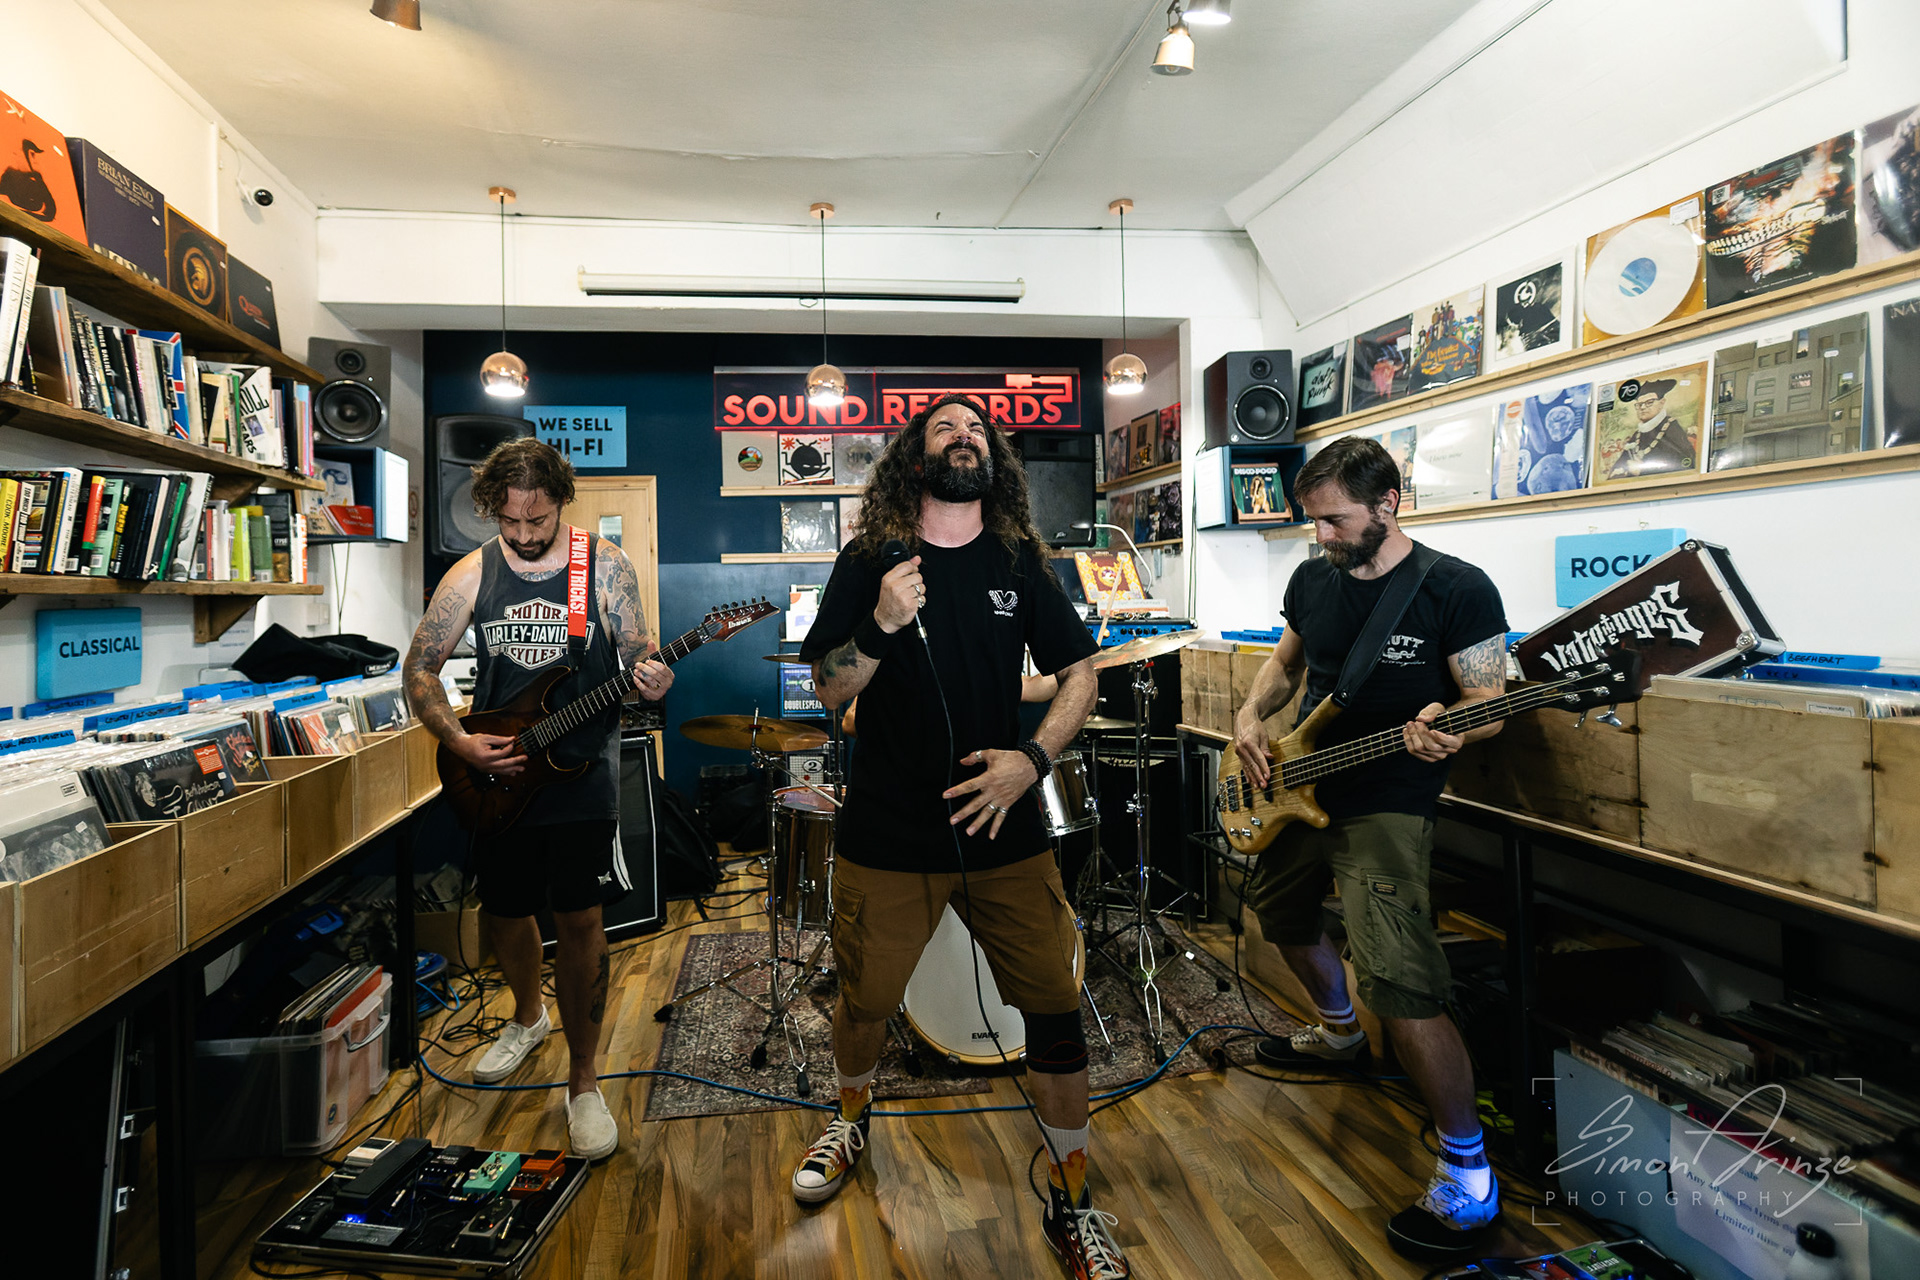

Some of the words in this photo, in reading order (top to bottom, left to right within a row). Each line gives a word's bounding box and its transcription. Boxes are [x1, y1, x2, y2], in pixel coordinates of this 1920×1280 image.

[97, 157, 131, 188] BRIAN
[723, 394, 868, 425] SOUND
[882, 394, 1072, 425] RERDS
[539, 417, 567, 431] WE
[572, 417, 613, 431] SELL
[547, 438, 603, 456] HI-FI
[571, 527, 588, 567] LFWAY
[570, 569, 587, 615] TRICKS!
[511, 602, 562, 620] MOTOR
[59, 636, 140, 659] CLASSICAL
[510, 647, 557, 665] CYCLES
